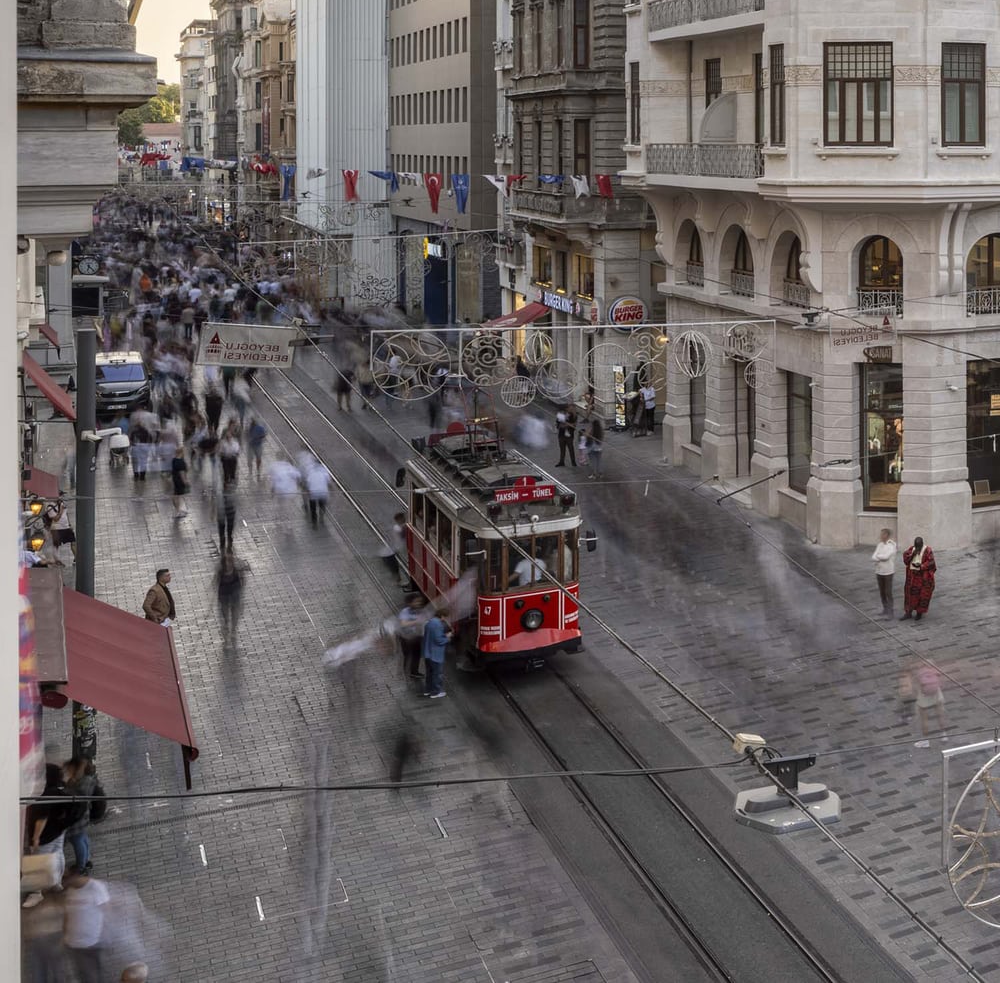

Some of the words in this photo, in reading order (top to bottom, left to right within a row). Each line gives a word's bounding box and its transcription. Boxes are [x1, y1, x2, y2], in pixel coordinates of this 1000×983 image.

[544, 291, 562, 310] BURGER
[562, 297, 573, 315] KING
[614, 305, 644, 316] BURGER
[614, 311, 644, 323] KING
[523, 477, 527, 487] 1
[495, 491, 519, 503] TAKSİM
[532, 488, 553, 498] TÜNEL
[484, 606, 492, 616] 47
